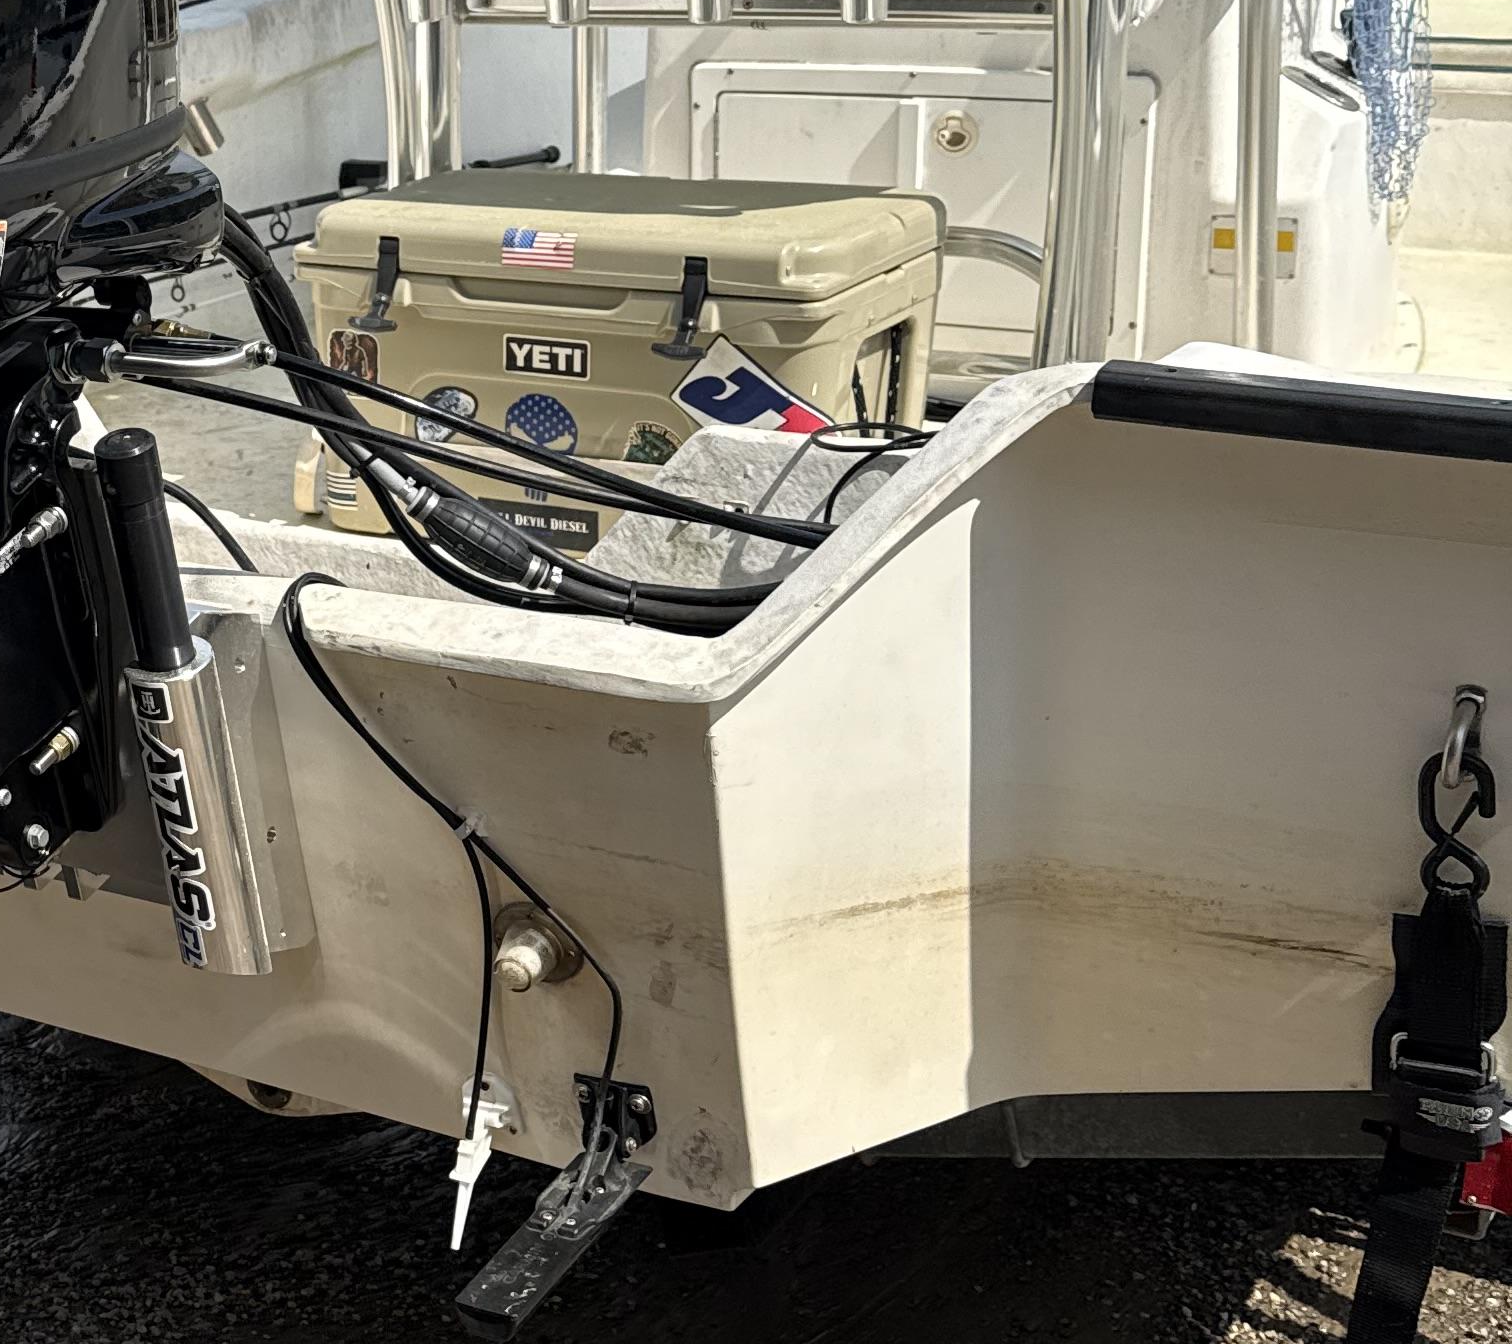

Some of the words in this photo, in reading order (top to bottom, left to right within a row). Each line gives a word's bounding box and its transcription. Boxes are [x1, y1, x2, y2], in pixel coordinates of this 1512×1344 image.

[509, 342, 583, 373] YETI
[514, 513, 548, 529] DEVIL
[549, 517, 590, 534] DIESEL
[137, 720, 214, 925] ATLAS
